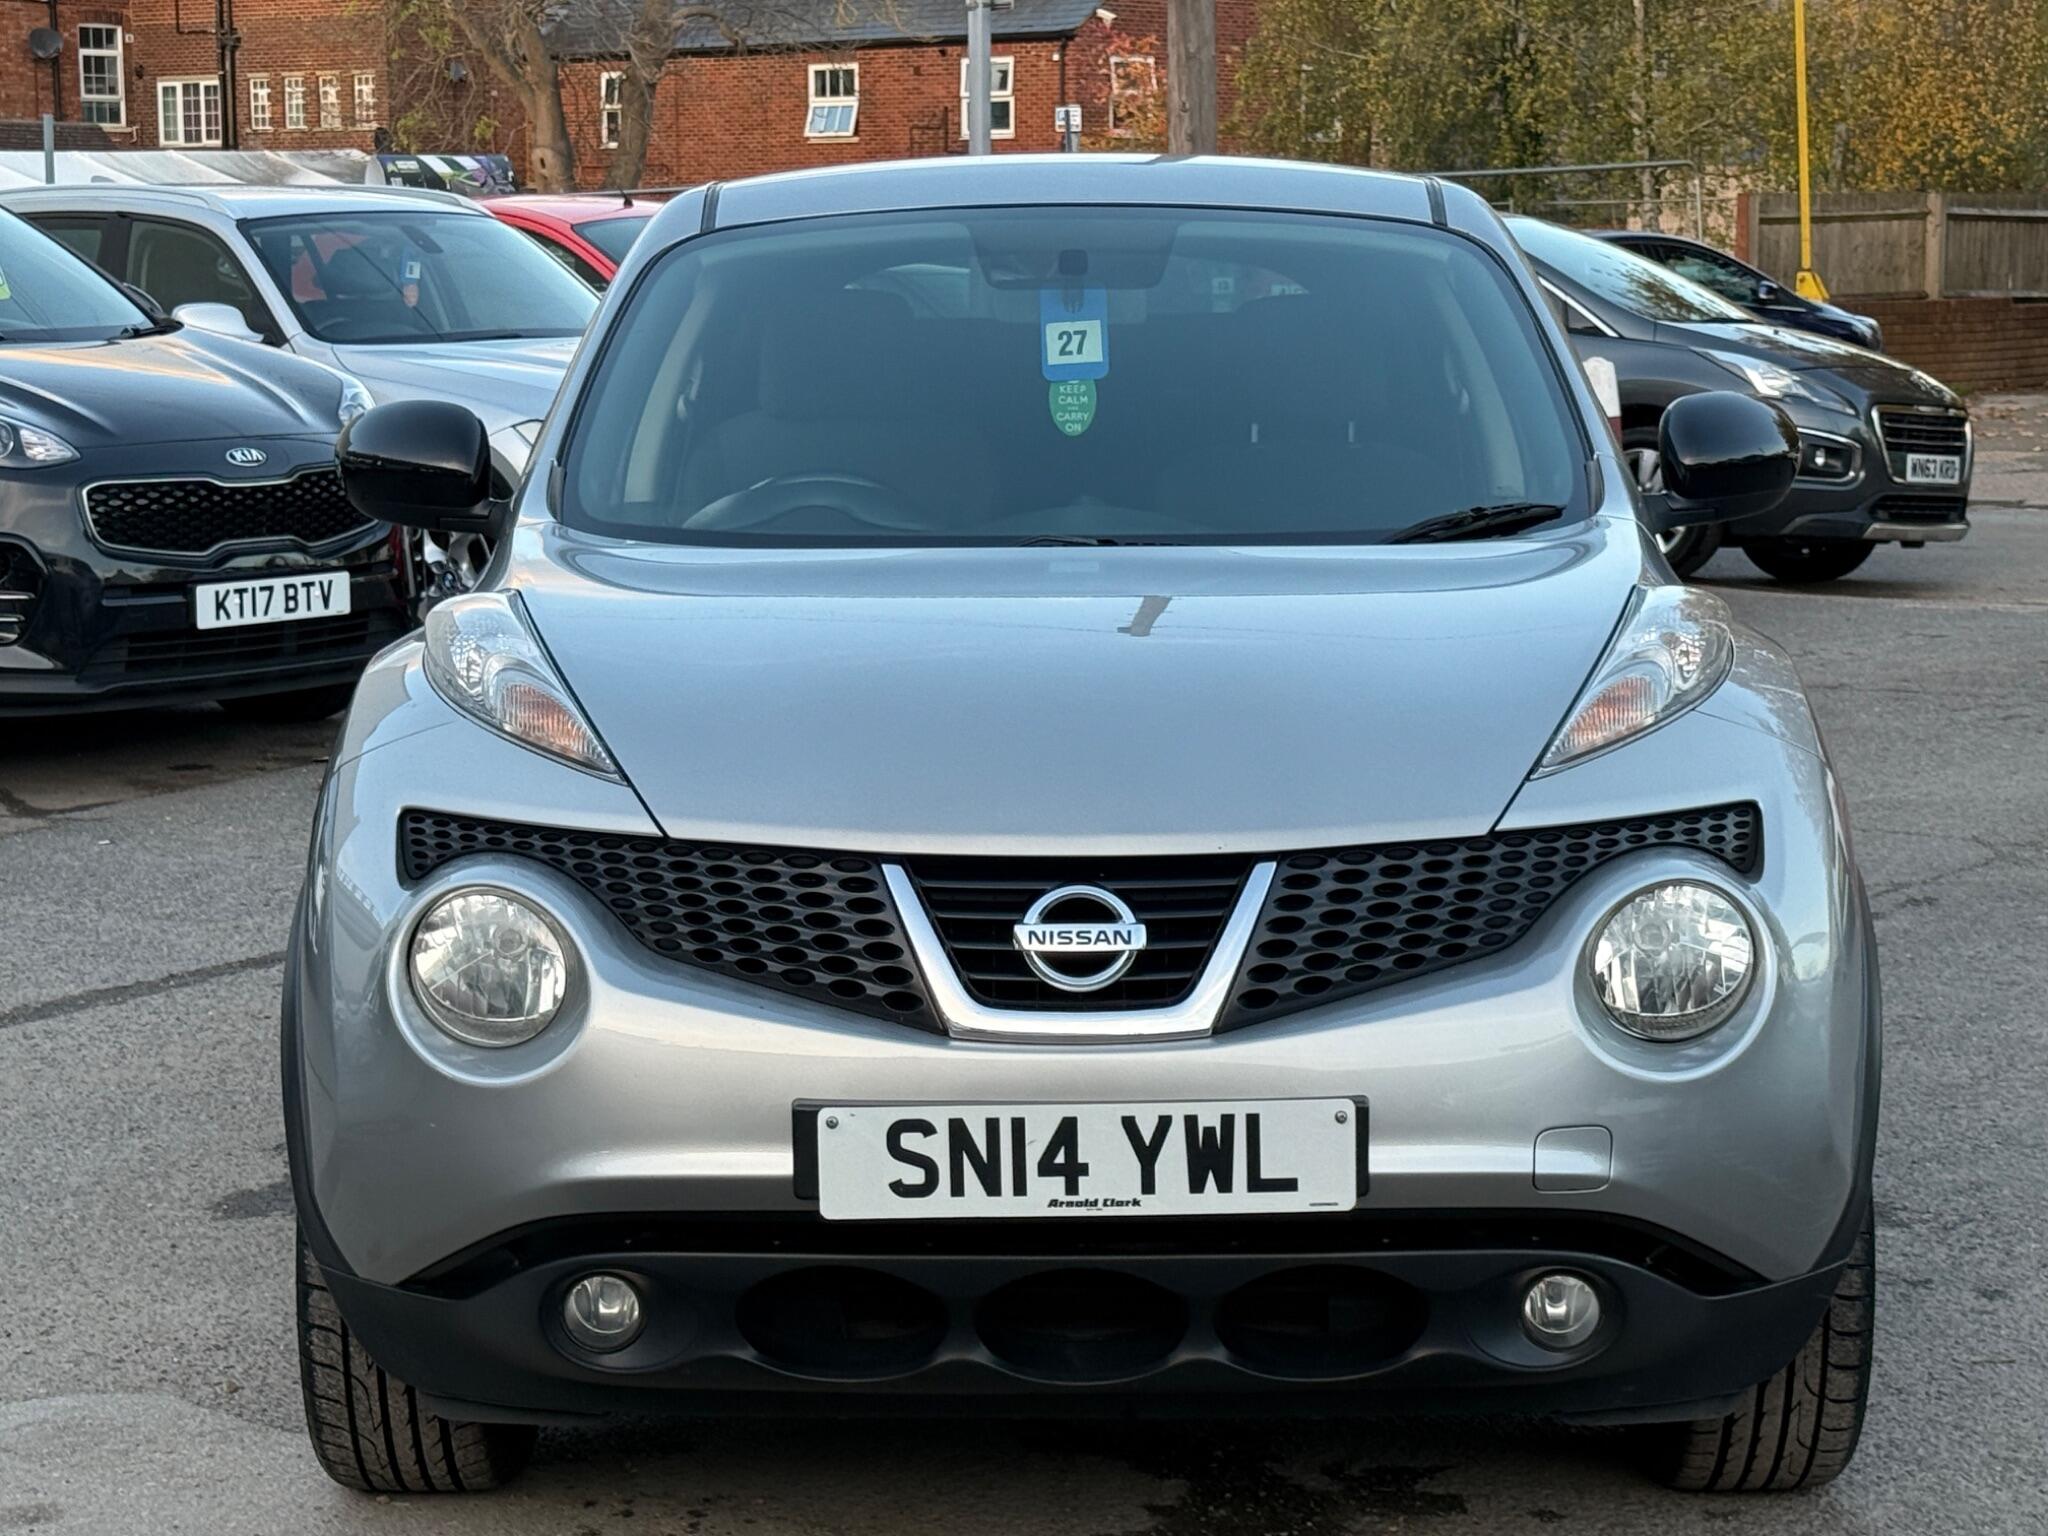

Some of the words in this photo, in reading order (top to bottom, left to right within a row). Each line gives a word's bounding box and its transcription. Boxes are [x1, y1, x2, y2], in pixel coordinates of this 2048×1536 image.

[1058, 330, 1087, 356] 27
[1059, 385, 1087, 394] KEEP
[1058, 395, 1089, 405] CALM
[1056, 412, 1090, 421] CARRY
[1065, 423, 1082, 432] ON
[232, 449, 263, 462] KIA
[215, 585, 274, 621] KT17
[284, 580, 333, 614] BTV
[1028, 930, 1132, 945] NISSAN
[886, 1116, 1089, 1198] SN14
[1121, 1113, 1298, 1195] YWL
[1047, 1198, 1099, 1208] Arnold
[1102, 1198, 1142, 1207] Clark
